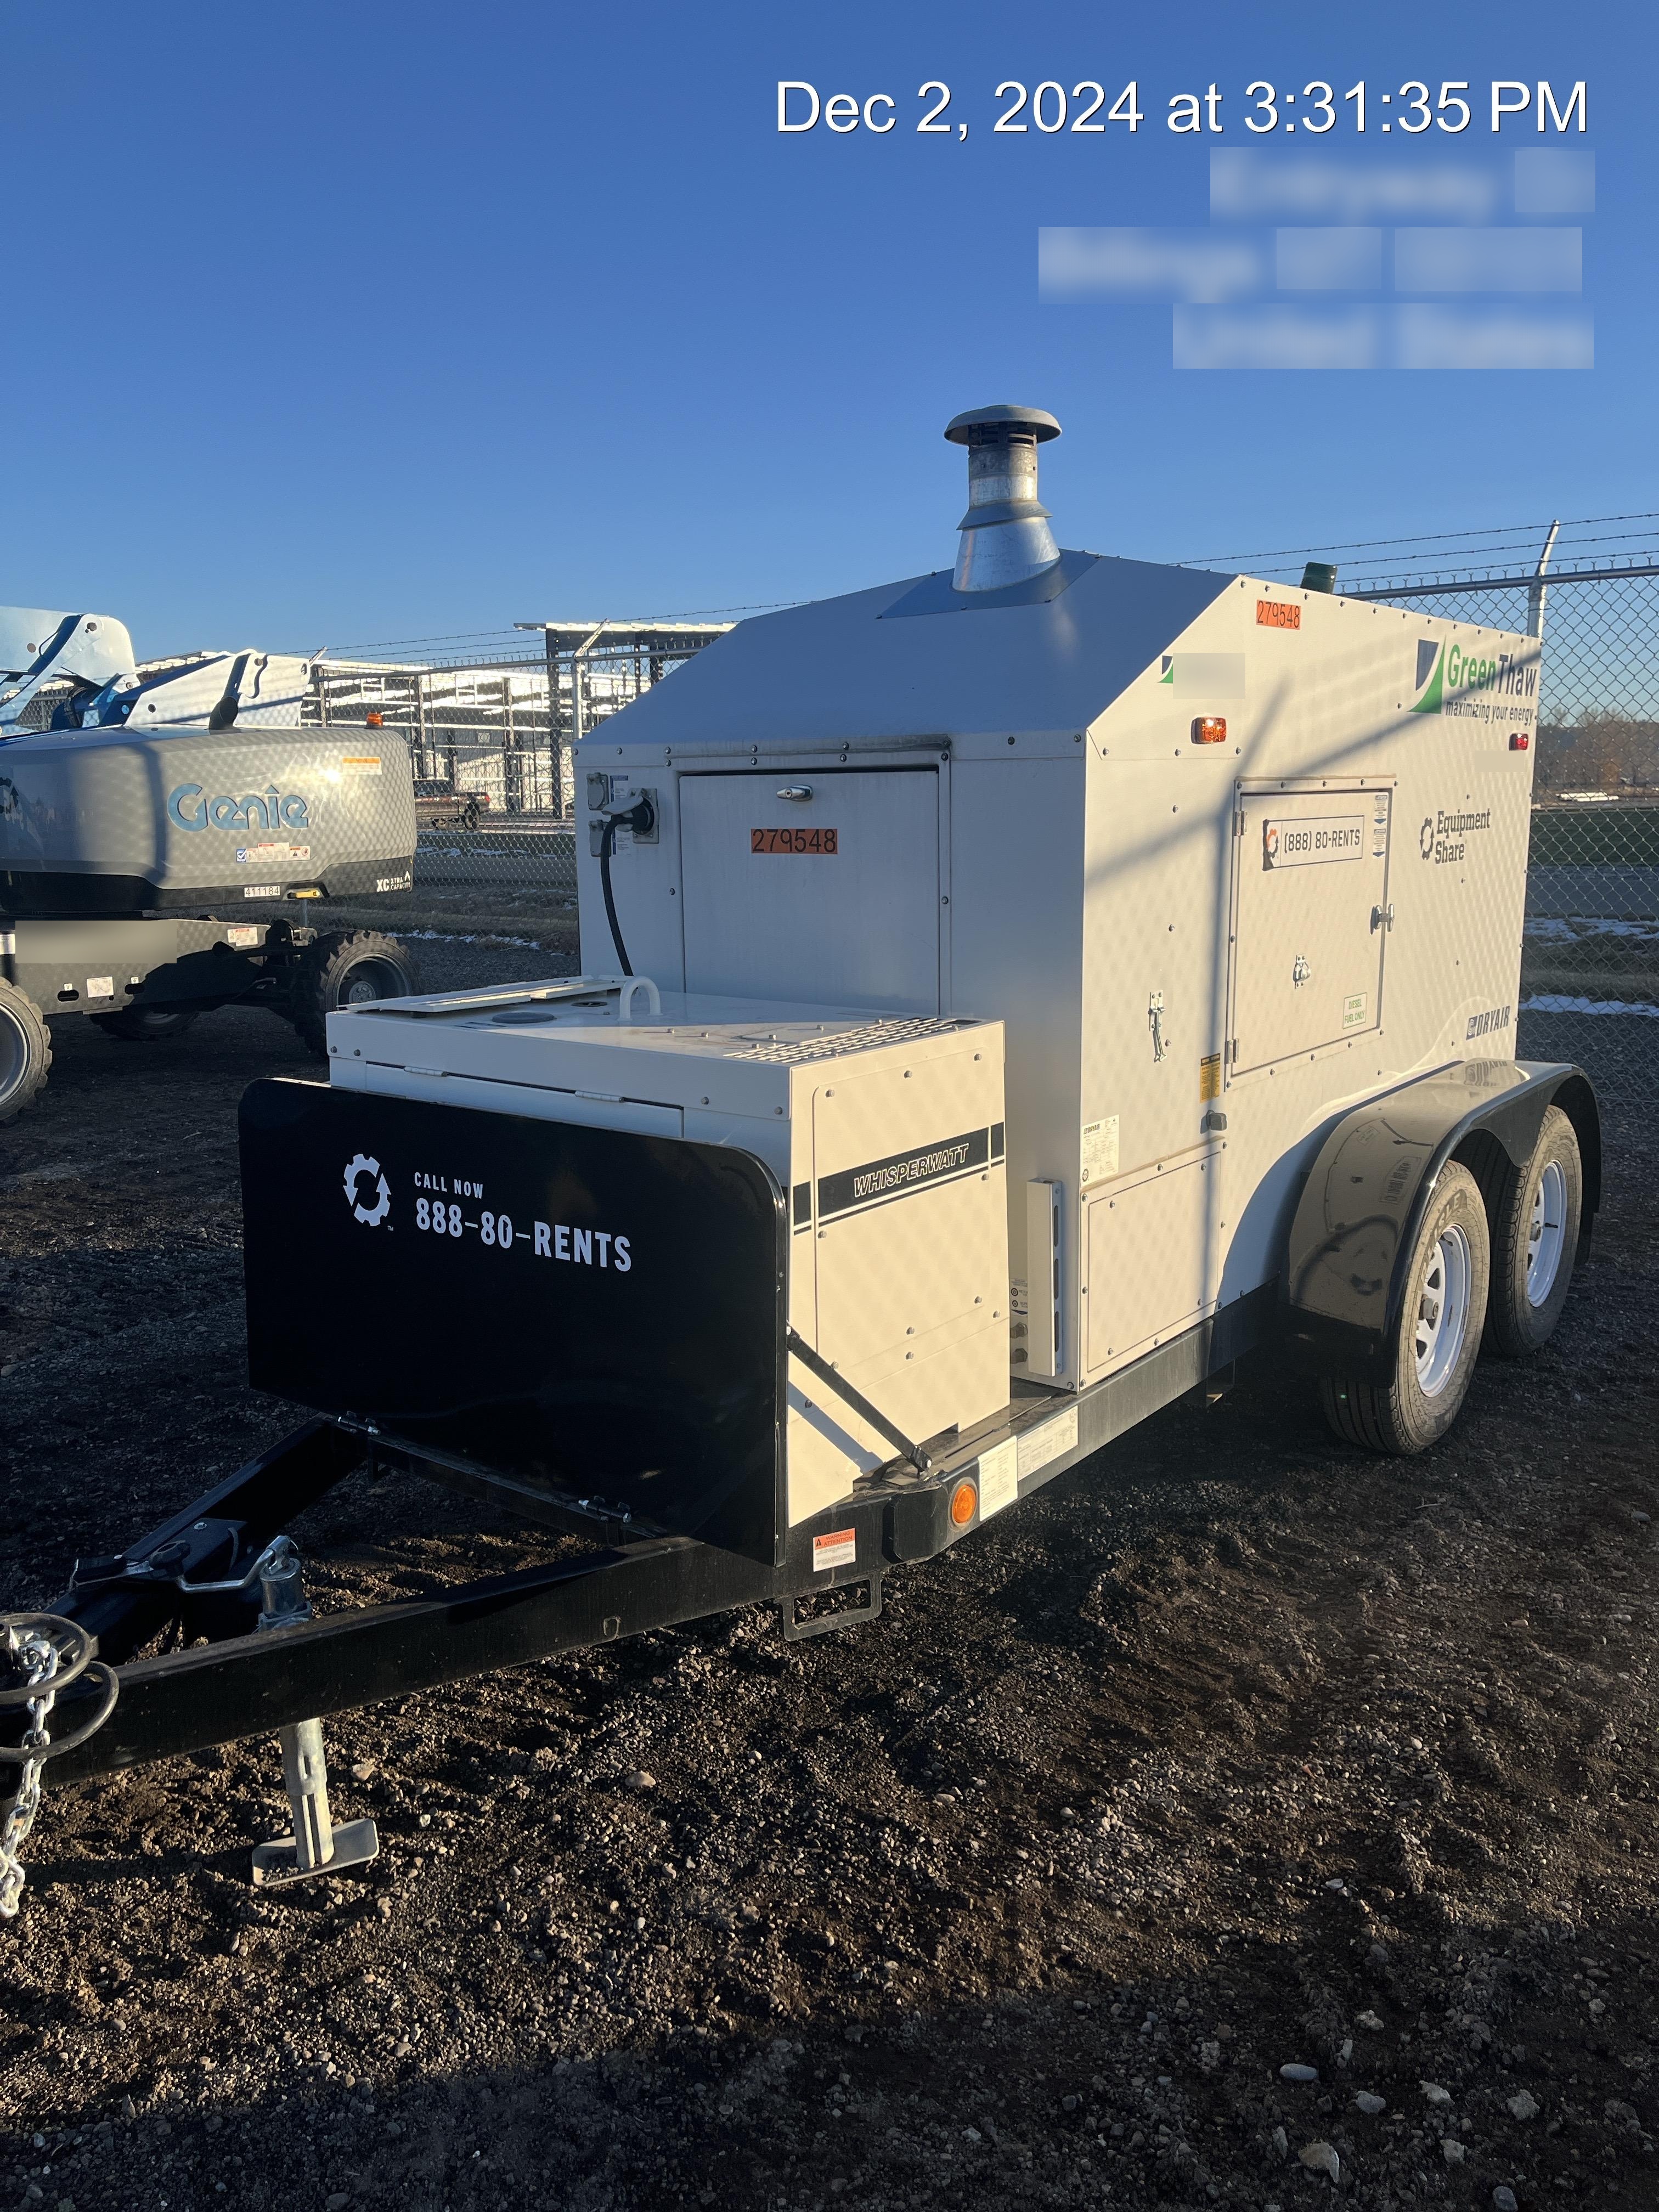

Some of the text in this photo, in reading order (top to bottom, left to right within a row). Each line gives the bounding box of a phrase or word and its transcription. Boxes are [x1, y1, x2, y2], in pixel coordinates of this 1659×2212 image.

[1257, 600, 1300, 629] 279548
[1446, 697, 1534, 726] maximizing your energy
[167, 783, 309, 832] Genie
[1436, 808, 1491, 839] Equipment
[753, 828, 836, 853] 279548
[1284, 831, 1312, 854] (888)
[1315, 829, 1361, 849] 80-RENTS
[1435, 840, 1465, 864] Share
[245, 886, 280, 896] 411184
[376, 878, 390, 892] XC
[1348, 999, 1362, 1009] DIESEL
[1344, 1010, 1365, 1024] FUEL ONLY
[1476, 1006, 1510, 1037] DRYAIR
[854, 1143, 969, 1198] WHISPERWATT
[414, 1172, 483, 1199] CALL NOW
[416, 1198, 632, 1272] 888-80-RENTS
[823, 1536, 853, 1546] ATTENTION
[826, 1531, 850, 1540] WARNING
